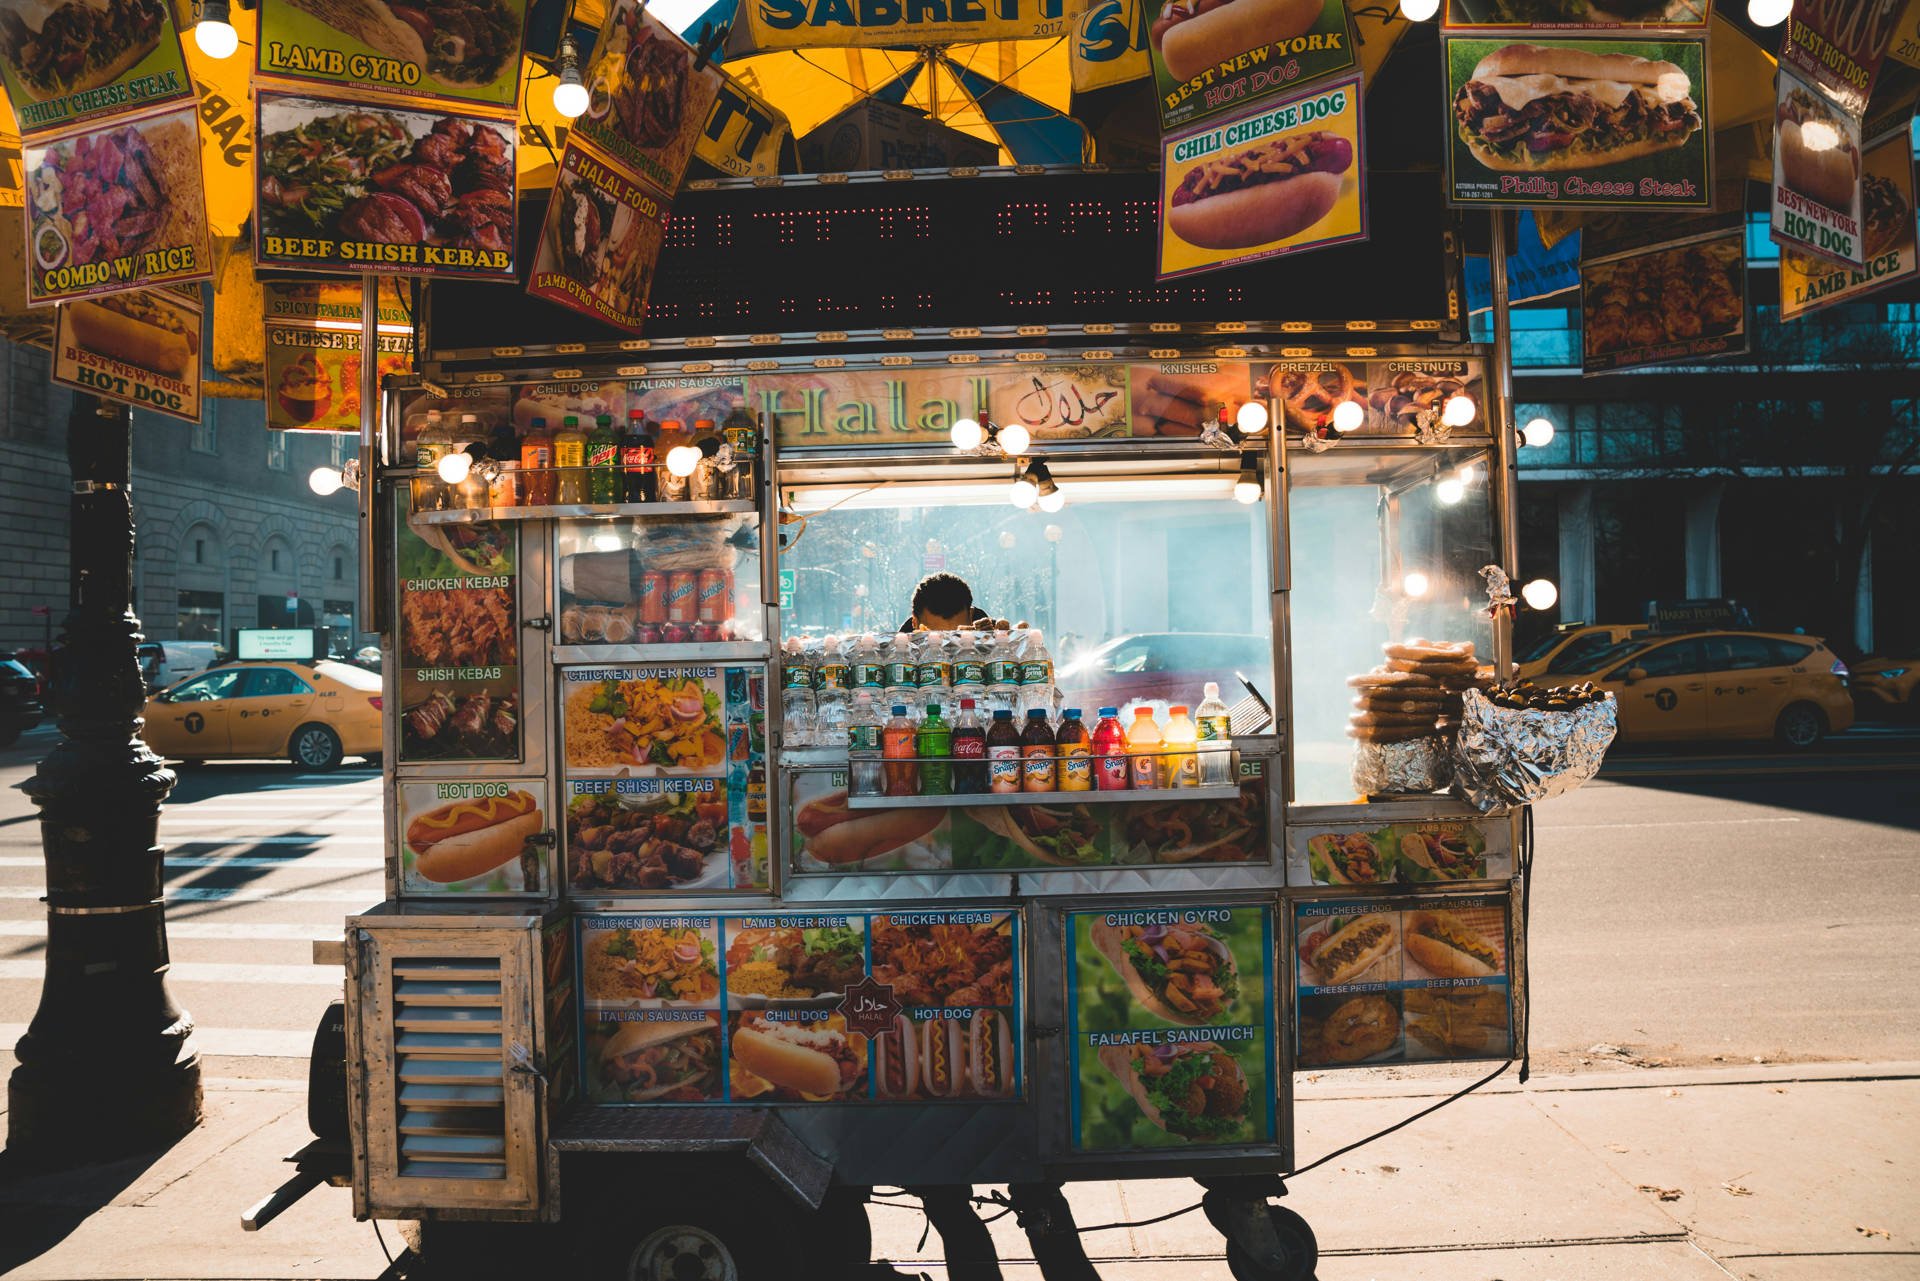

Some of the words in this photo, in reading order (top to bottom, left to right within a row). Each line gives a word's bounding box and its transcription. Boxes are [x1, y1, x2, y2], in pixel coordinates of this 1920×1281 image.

[1031, 22, 1063, 35] 2017
[1791, 19, 1823, 56] BEST
[1821, 41, 1845, 73] HOT
[1843, 60, 1869, 89] DOG
[270, 41, 345, 76] LAMB
[348, 54, 421, 86] GYRO
[1164, 68, 1220, 109] BEST
[1218, 44, 1270, 77] NEW
[1274, 33, 1342, 58] YORK
[1203, 79, 1247, 108] HOT
[1250, 60, 1301, 93] DOG
[20, 99, 70, 126] PHILLY
[71, 83, 128, 114] CHEESE
[128, 70, 182, 98] STEAK
[1175, 129, 1222, 161] CHILI
[1224, 106, 1297, 147] CHEESE
[1299, 93, 1345, 119] DOG
[722, 154, 752, 175] 2017
[576, 157, 622, 198] HALAL
[623, 187, 658, 218] FOOD
[1500, 176, 1560, 199] Philly
[1563, 176, 1635, 196] Cheese
[1640, 178, 1698, 197] Steak
[1777, 186, 1804, 212] BEST
[1804, 200, 1830, 225] NEW
[1830, 212, 1858, 237] YORK
[1783, 211, 1817, 243] HOT
[1819, 226, 1853, 257] DOG
[265, 236, 335, 259] BEEF
[339, 241, 420, 265] SHISH
[422, 246, 511, 270] KEBAB
[43, 258, 112, 292] COMBO
[144, 245, 196, 276] RICE
[1794, 271, 1846, 306] LAMB
[537, 273, 567, 290] LAMB
[567, 280, 592, 307] GYRO
[594, 299, 629, 325] CHICKEN
[274, 300, 310, 316] SPICY
[271, 329, 345, 350] CHEESE
[65, 345, 107, 370] BEST
[111, 360, 151, 383] NEW
[151, 374, 193, 398] YORK
[1161, 363, 1218, 374] KNISHES
[1280, 363, 1337, 373] PRETZEL
[1388, 361, 1462, 372] CHESTNUTS
[77, 365, 130, 395] HOT
[133, 384, 182, 411] DOG
[537, 383, 568, 395] CHILI
[571, 381, 599, 393] DOG
[629, 379, 677, 390] ITALIAN
[757, 378, 989, 435] Halal
[407, 578, 462, 591] CHICKEN
[466, 576, 510, 589] KEBAB
[417, 670, 455, 682] SHISH
[458, 668, 502, 680] KEBAB
[567, 668, 633, 680] CHICKEN
[636, 667, 678, 679] OVER
[681, 666, 717, 678] RICE
[438, 783, 470, 799] HOT
[473, 783, 508, 798] DOG
[575, 782, 611, 794] BEEF
[616, 781, 660, 793] SHISH
[663, 780, 714, 793] KEBAB
[1416, 824, 1440, 833] LAMB
[1441, 823, 1465, 832] GYRO
[1305, 906, 1330, 917] CHILI
[1332, 904, 1369, 915] CHEESE
[588, 919, 642, 930] CHICKEN
[645, 918, 679, 929] OVER
[680, 918, 711, 928] RICE
[742, 918, 777, 929] LAMB
[780, 917, 816, 928] OVER
[818, 917, 847, 927] RICE
[890, 914, 945, 926] CHICKEN
[948, 913, 992, 925] KEBAB
[1106, 917, 1179, 932] CHICKEN
[1184, 915, 1232, 929] GYRO
[1314, 984, 1349, 995] CHEESE
[1426, 979, 1452, 988] BEEF
[1453, 978, 1482, 987] PATTY
[599, 1012, 644, 1022] ITALIAN
[647, 1010, 707, 1022] SAUSAGE
[766, 1010, 798, 1021] CHILI
[800, 1010, 829, 1021] DOG
[914, 1009, 942, 1020] HOT
[944, 1008, 972, 1019] DOG
[1089, 1036, 1162, 1052] FALAFEL
[1166, 1032, 1254, 1048] SANDWICH
